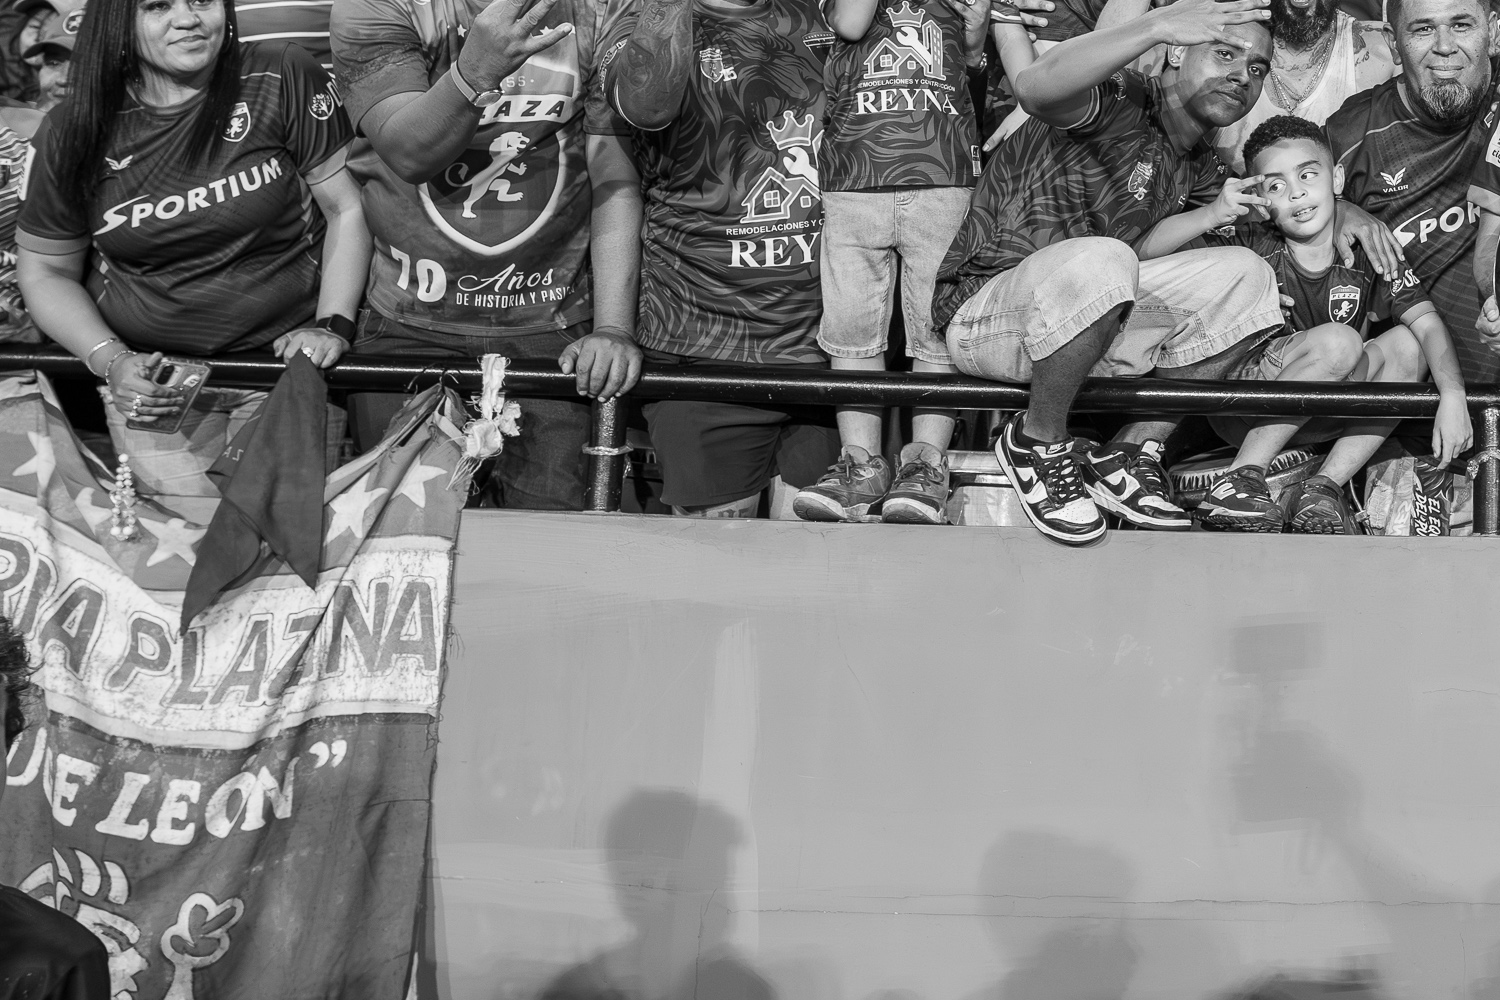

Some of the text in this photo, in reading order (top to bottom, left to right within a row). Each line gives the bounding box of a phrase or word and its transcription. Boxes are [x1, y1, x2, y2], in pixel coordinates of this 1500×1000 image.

[480, 100, 566, 119] AZA
[856, 88, 959, 115] REYNA
[93, 157, 283, 236] SPORTIUM
[1382, 184, 1409, 193] VALOR
[726, 220, 810, 236] REMODELACIONES
[727, 232, 820, 268] REY
[457, 263, 554, 293] Años
[456, 292, 469, 306] DE
[475, 293, 526, 309] HISTORIA
[530, 292, 537, 304] Y
